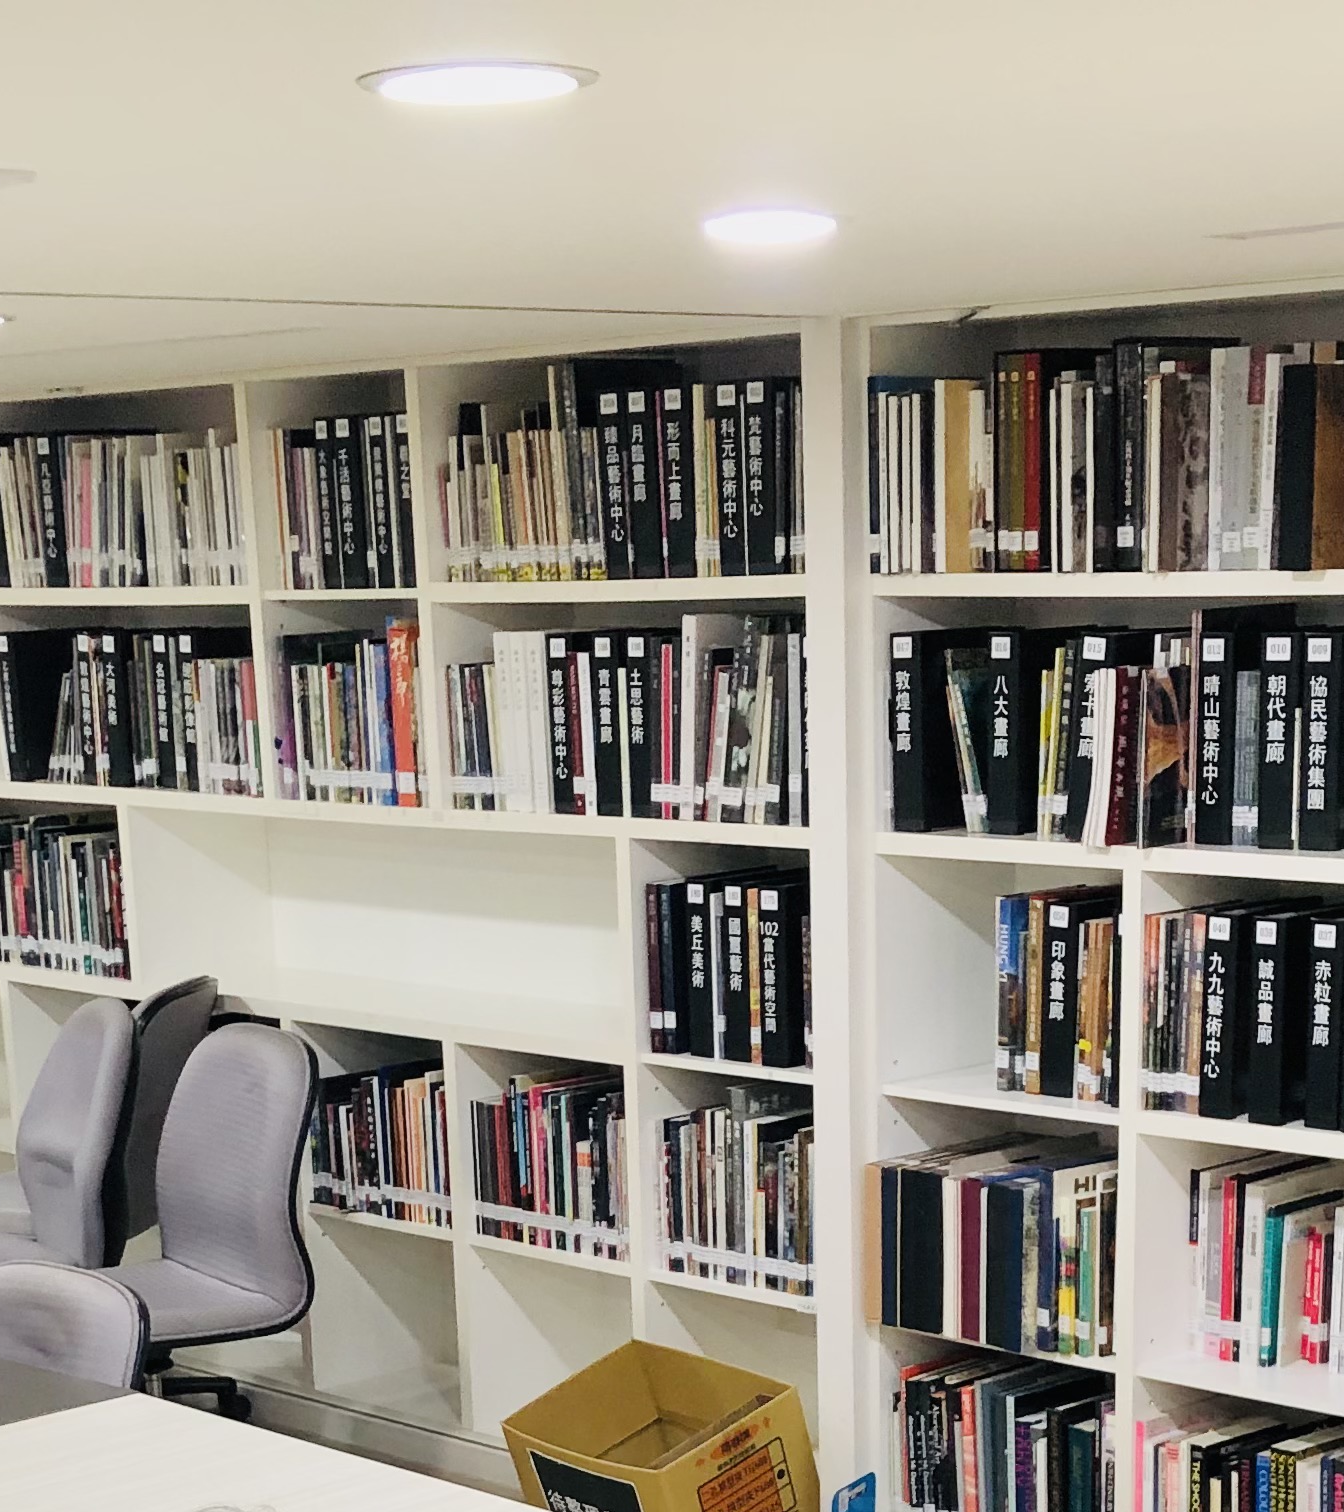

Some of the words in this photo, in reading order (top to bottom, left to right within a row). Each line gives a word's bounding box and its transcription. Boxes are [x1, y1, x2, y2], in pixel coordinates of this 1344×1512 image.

[666, 421, 682, 521] 形而上畫廊
[895, 670, 911, 752] 敦煌畫廊
[993, 675, 1008, 758] 八大畫廊
[1202, 675, 1221, 805] 晴山藝術中心
[1265, 675, 1287, 764] 朝代畫廊
[760, 922, 779, 936] 102
[1049, 941, 1066, 1021] 印象畫廊
[1204, 952, 1225, 1079] 九九藝術中心
[1257, 959, 1274, 1045] 誠品畫廊
[1312, 960, 1331, 1047] 赤粒畫廊
[1191, 1461, 1201, 1482] THE
